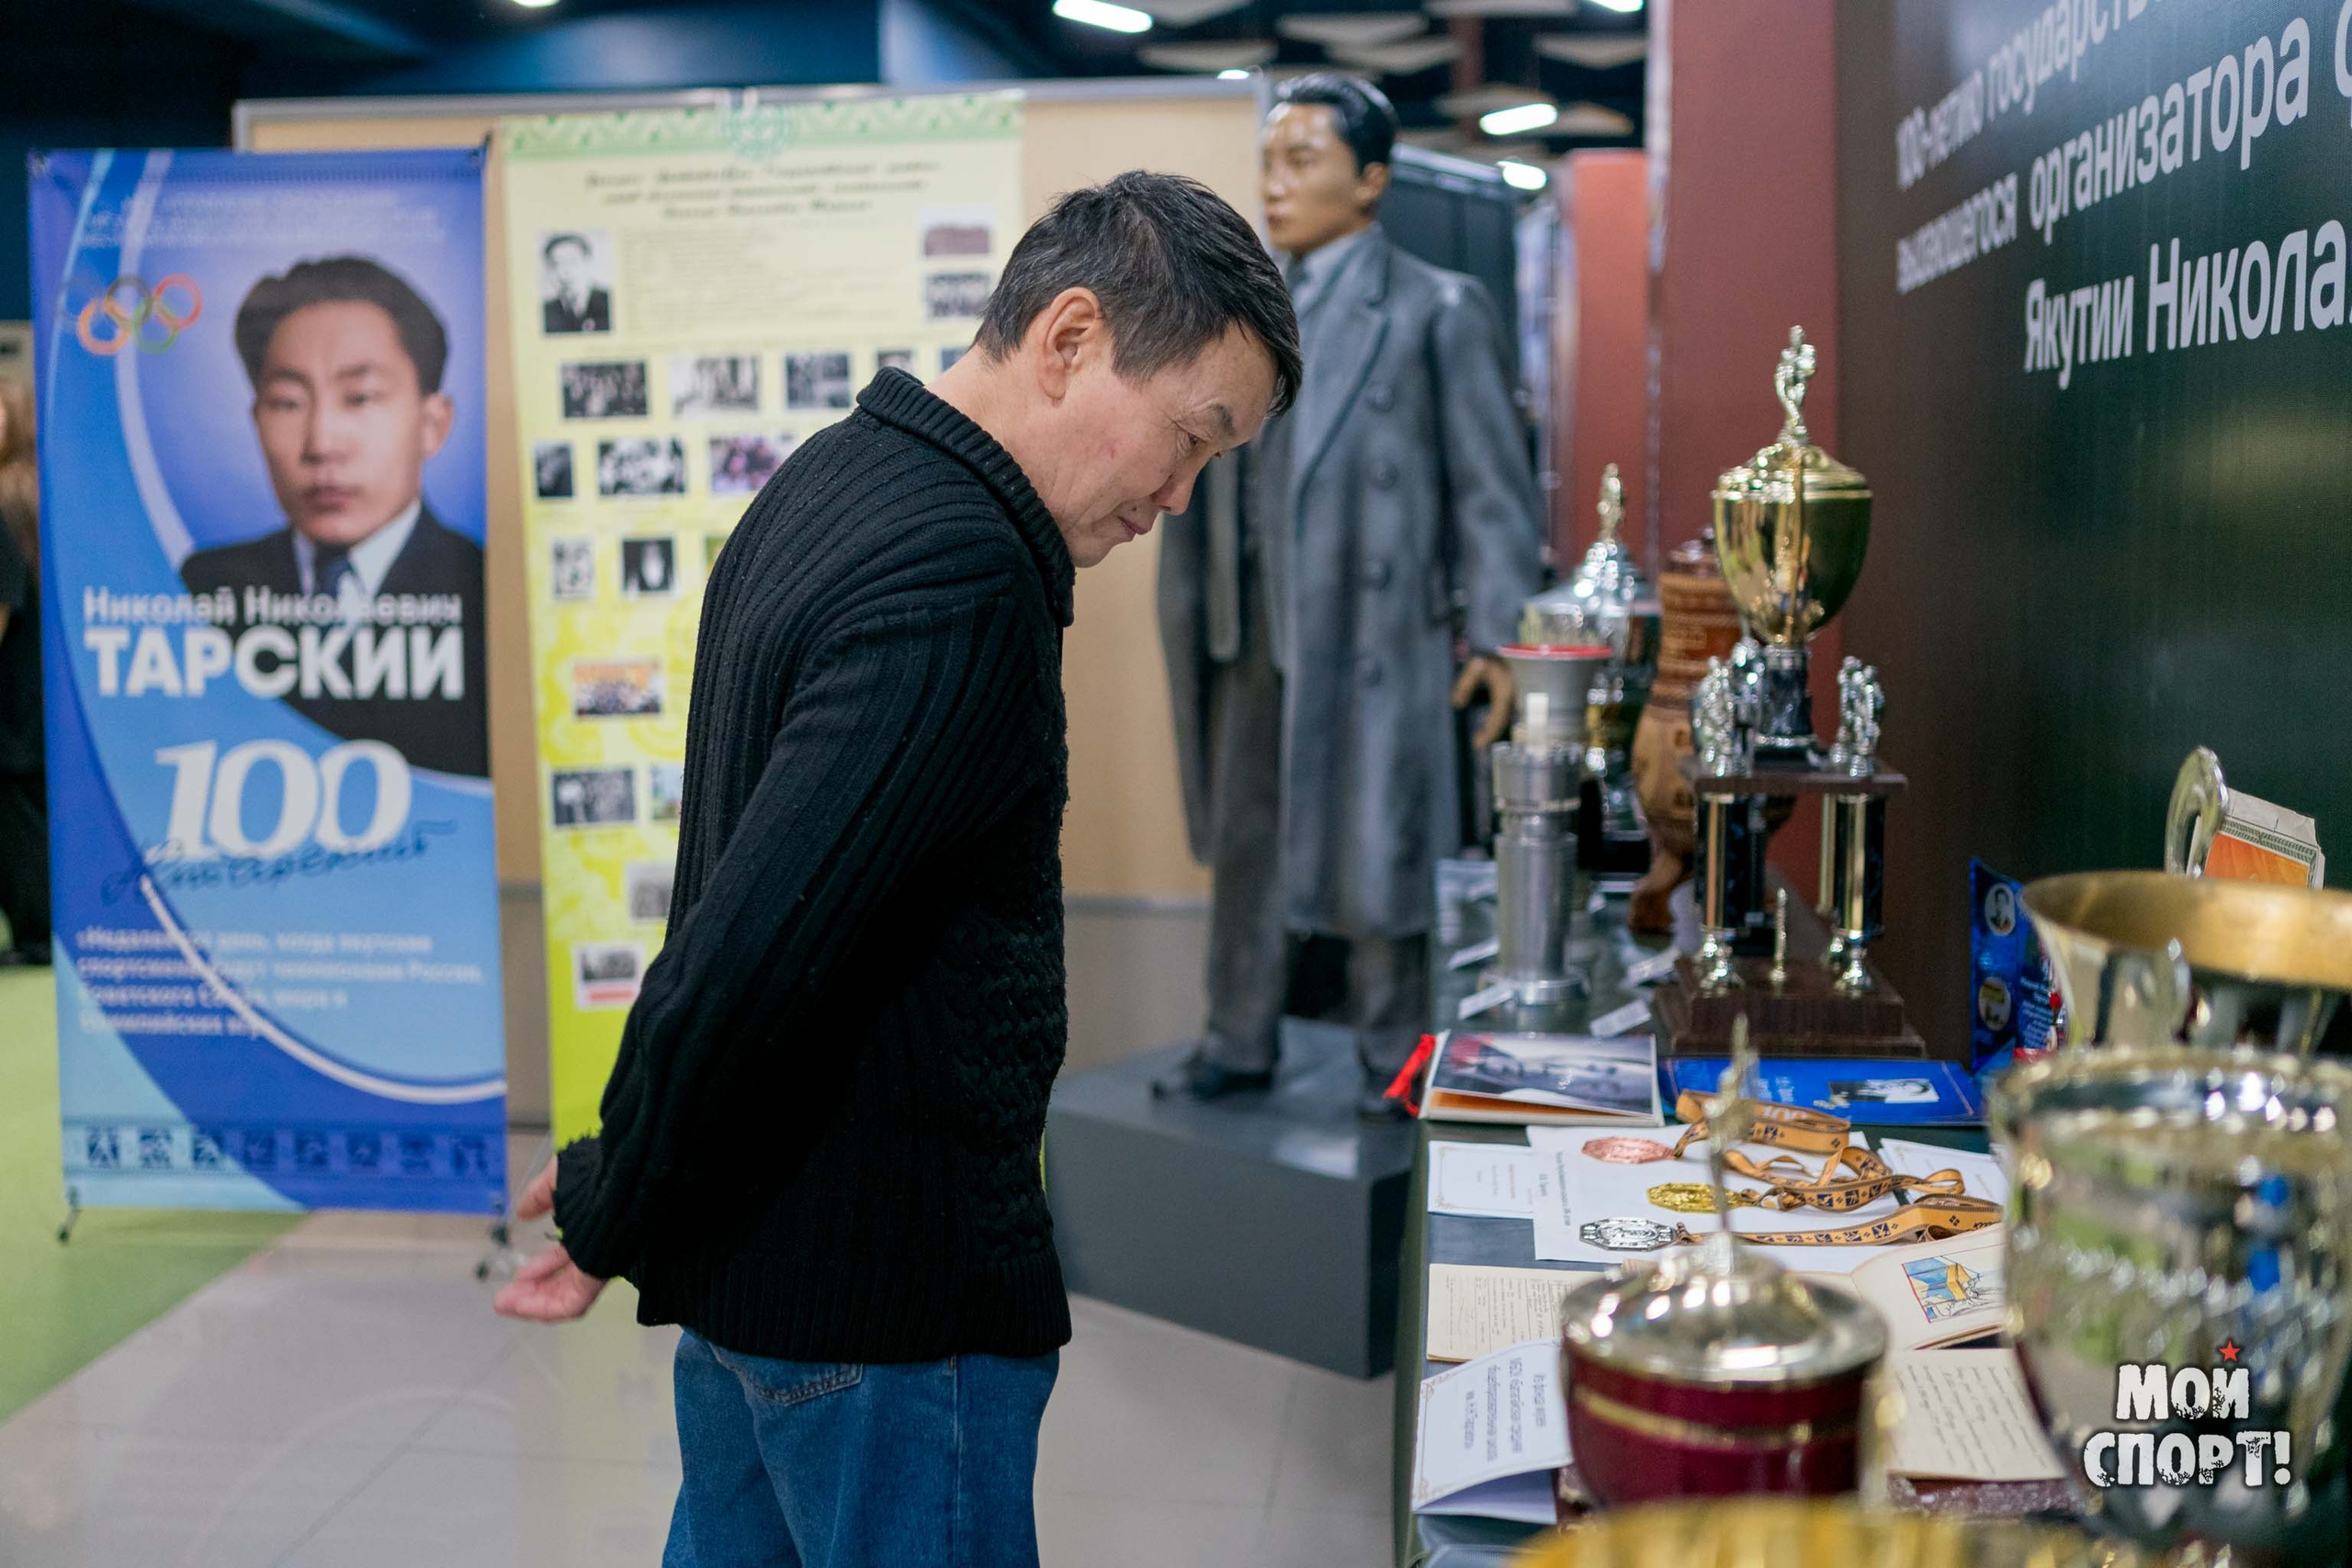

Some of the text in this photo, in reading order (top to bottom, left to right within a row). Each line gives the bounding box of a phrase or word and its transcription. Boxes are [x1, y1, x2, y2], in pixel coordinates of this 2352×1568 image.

[2029, 17, 2311, 245] организатора
[2024, 219, 2352, 390] Якутии Никола
[83, 585, 237, 626] Николай
[144, 739, 412, 864] 100
